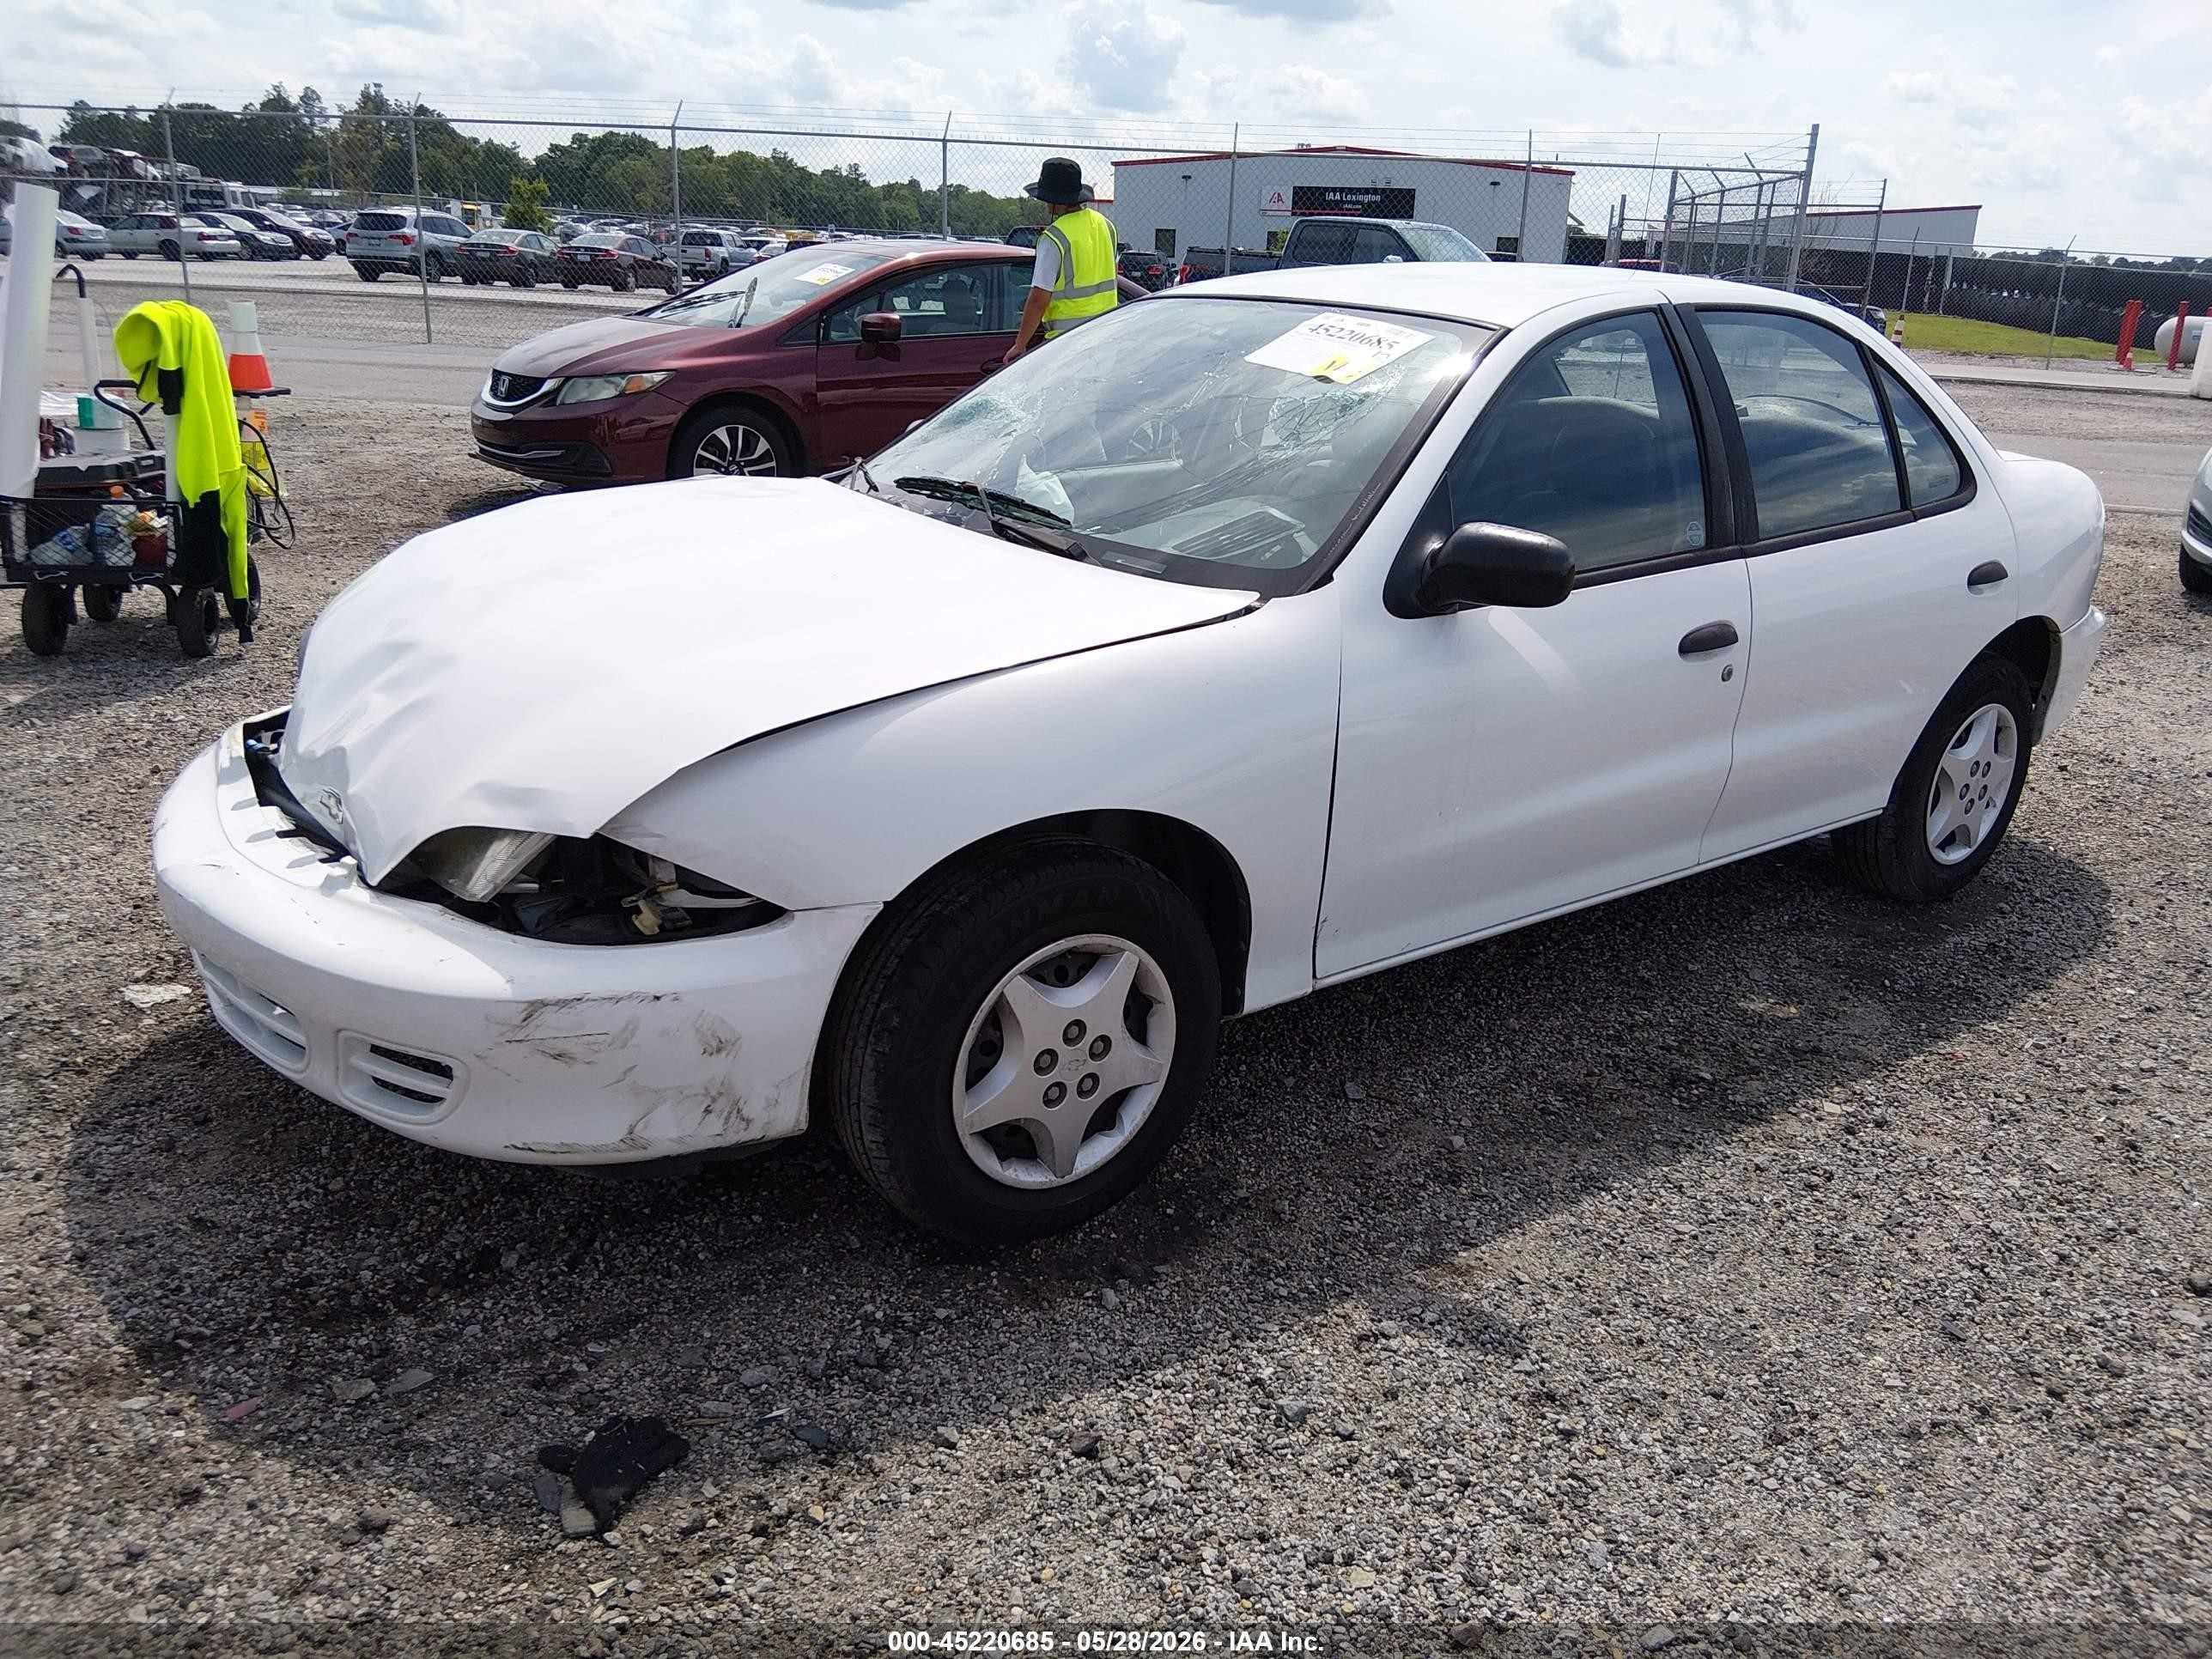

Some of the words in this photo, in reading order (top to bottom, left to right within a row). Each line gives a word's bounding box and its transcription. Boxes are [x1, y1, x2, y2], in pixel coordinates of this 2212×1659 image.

[1325, 191, 1341, 202] IAA
[1342, 191, 1381, 203] Lexington
[1308, 323, 1401, 350] 45220685
